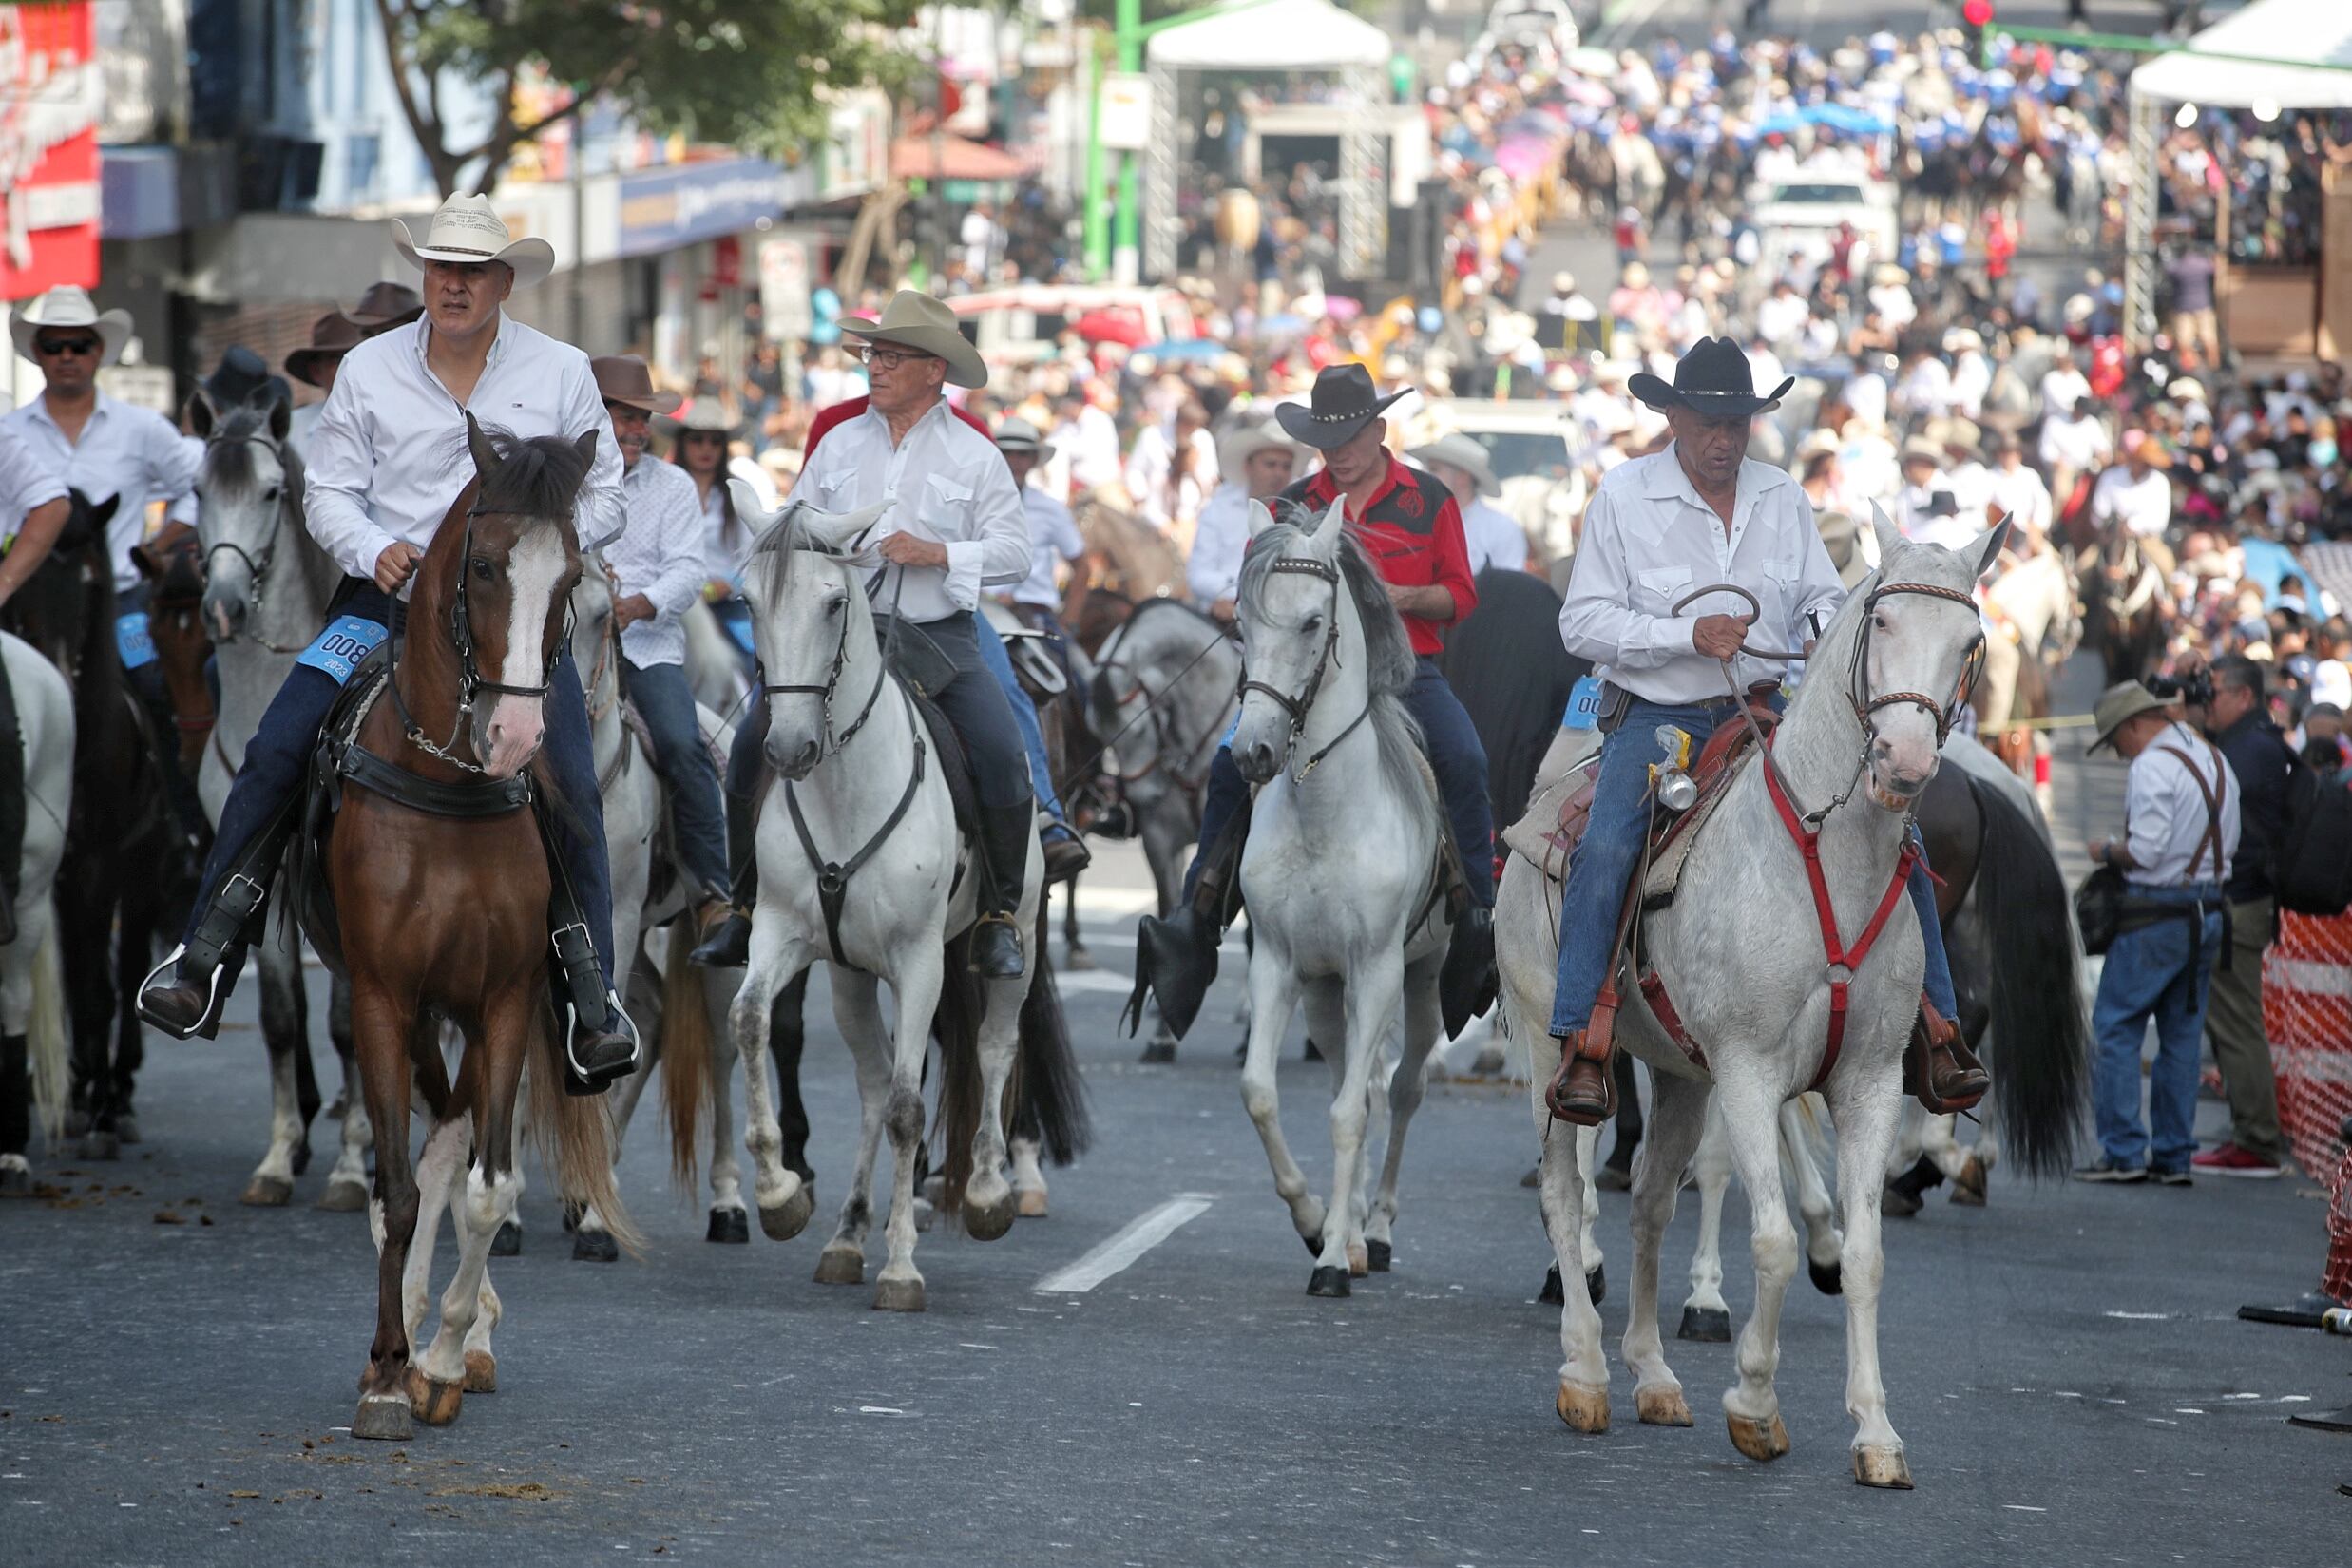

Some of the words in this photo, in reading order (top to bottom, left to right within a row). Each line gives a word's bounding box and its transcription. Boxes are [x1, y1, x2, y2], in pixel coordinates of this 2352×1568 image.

[320, 633, 370, 666] 008
[324, 658, 348, 677] 2023
[1578, 697, 1601, 715] 00
